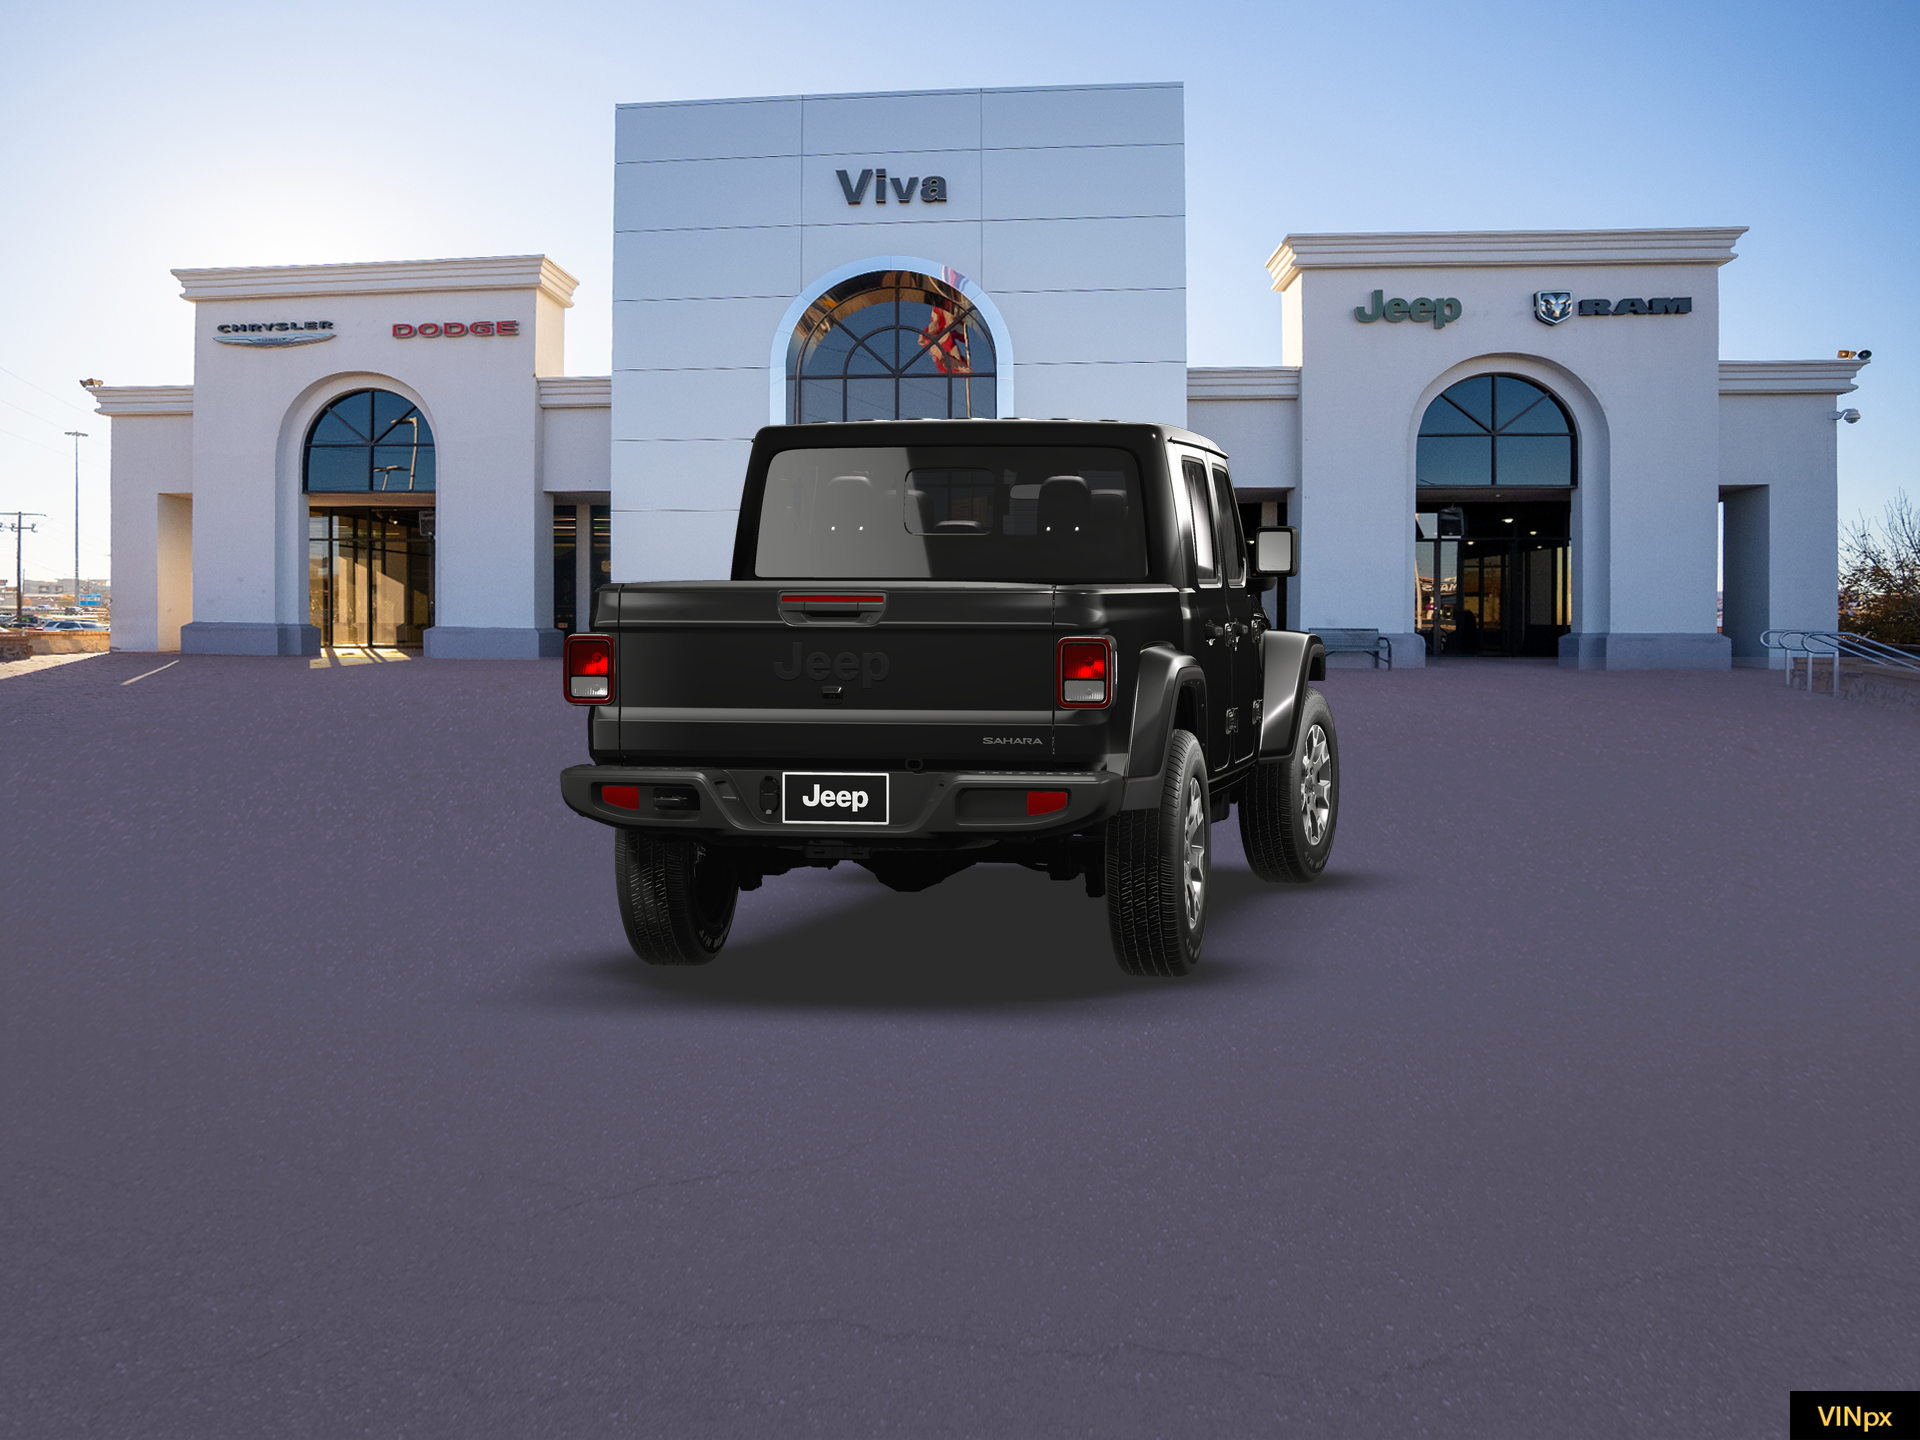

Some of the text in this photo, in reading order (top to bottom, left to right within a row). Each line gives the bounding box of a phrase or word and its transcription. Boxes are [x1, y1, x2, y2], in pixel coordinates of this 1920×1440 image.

[835, 168, 947, 205] Viva
[1354, 289, 1463, 330] Jeep
[1578, 297, 1692, 316] RAM
[216, 320, 334, 334] CHRYSLER
[392, 320, 520, 339] DODGE
[773, 642, 890, 689] Jeep
[982, 737, 1043, 745] SAHARA
[802, 783, 869, 812] Jeep
